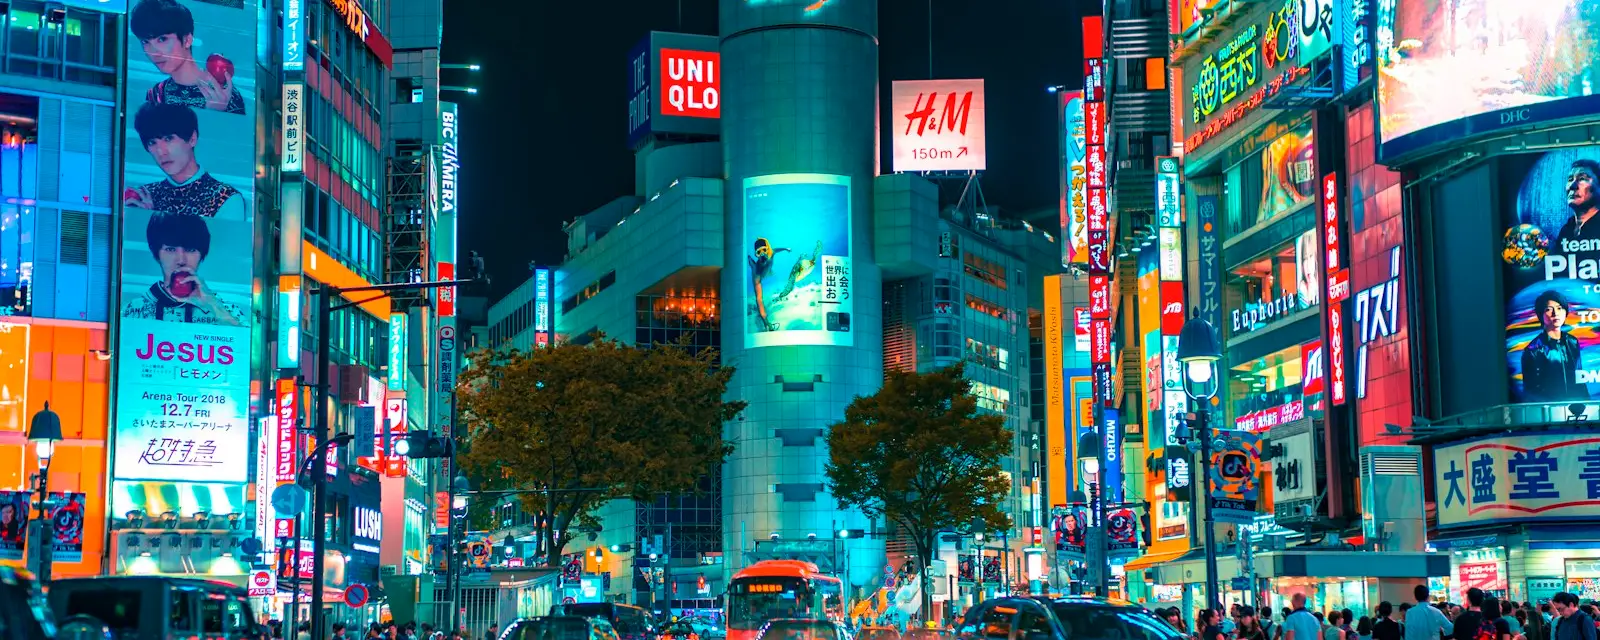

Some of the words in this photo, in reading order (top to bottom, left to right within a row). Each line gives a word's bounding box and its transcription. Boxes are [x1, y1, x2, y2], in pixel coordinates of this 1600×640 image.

[633, 52, 645, 93] THE
[668, 57, 713, 83] UNI
[629, 86, 649, 135] PRIME
[668, 85, 718, 112] QLO
[286, 89, 298, 164] 渋谷駅前ビル
[442, 112, 454, 139] BIC
[904, 91, 973, 137] H&M
[1500, 108, 1530, 125] DHC
[911, 147, 953, 160] 150m
[442, 142, 460, 212] CAMERA
[826, 265, 849, 275] 世界に
[1544, 253, 1600, 281] Pla
[1164, 302, 1182, 315] JTB
[1232, 292, 1295, 332] Euphoria
[136, 333, 234, 365] Jesus
[210, 335, 234, 343] SINGLE
[440, 326, 455, 351] OS
[142, 391, 172, 401] Arena
[176, 393, 198, 402] Tour
[201, 394, 226, 404] 2018
[161, 403, 192, 417] 12.7
[195, 409, 211, 418] FRI
[132, 419, 233, 432] さいたまスーパーアリーナ
[279, 407, 292, 475] サンドラッグ
[1106, 420, 1117, 462] MIZUHO
[1172, 457, 1189, 488] HUB
[354, 506, 381, 541] LUSH
